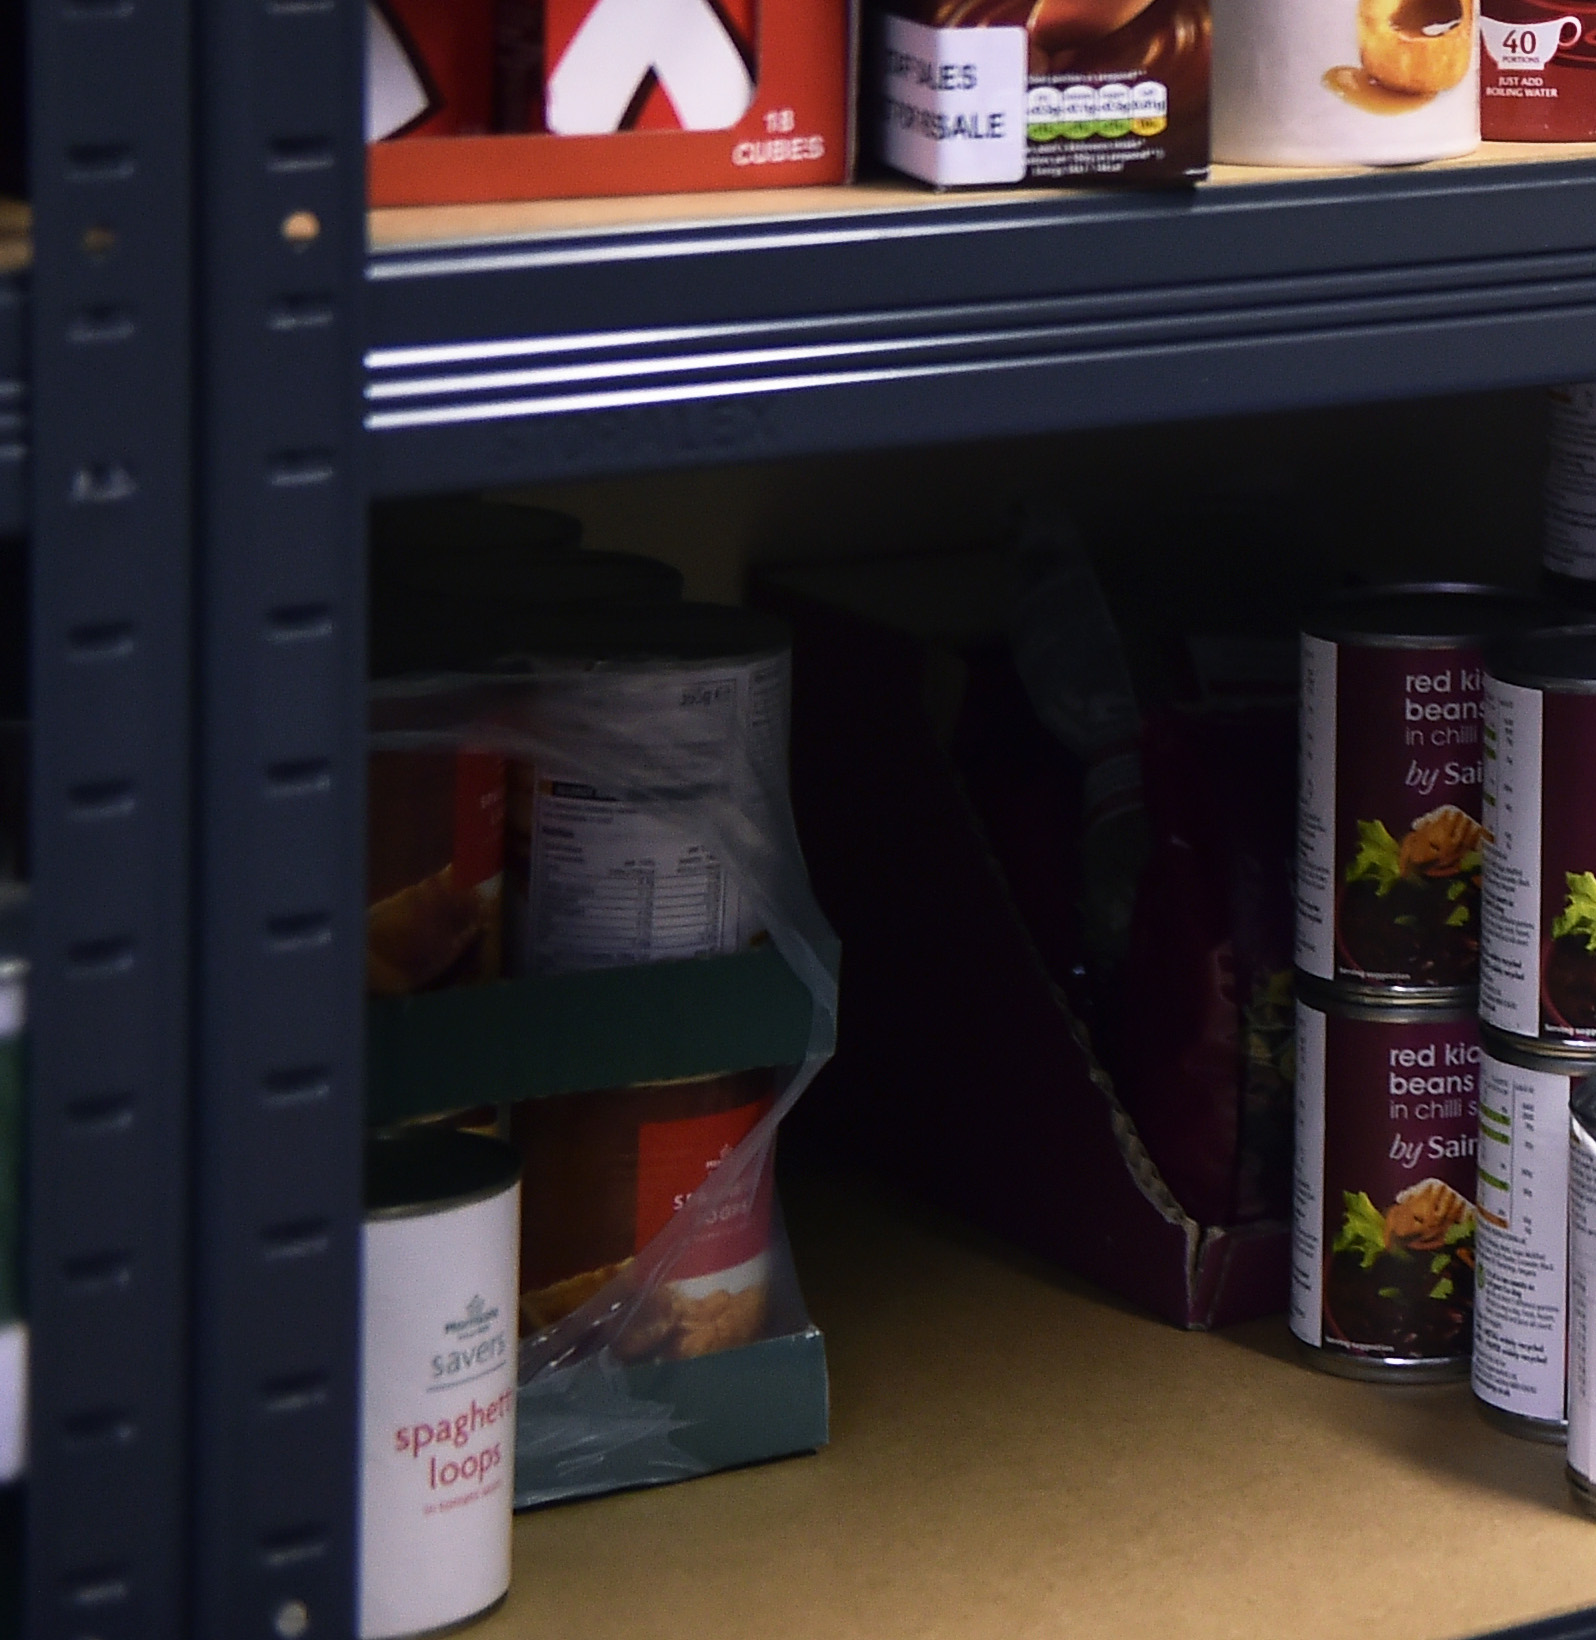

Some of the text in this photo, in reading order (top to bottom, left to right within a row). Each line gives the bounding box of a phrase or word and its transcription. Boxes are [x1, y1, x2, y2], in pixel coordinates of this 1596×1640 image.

[1502, 29, 1538, 55] 40
[1502, 55, 1541, 64] PORTIONS
[1486, 87, 1559, 98] BOILING WATER
[1498, 76, 1544, 86] JUST ADD
[731, 134, 826, 166] CUBES
[1405, 669, 1452, 694] red
[1389, 1043, 1436, 1068] red
[1389, 1071, 1475, 1096] beans
[1390, 1100, 1409, 1120] in
[431, 1331, 507, 1378] savers
[428, 1442, 502, 1492] loops
